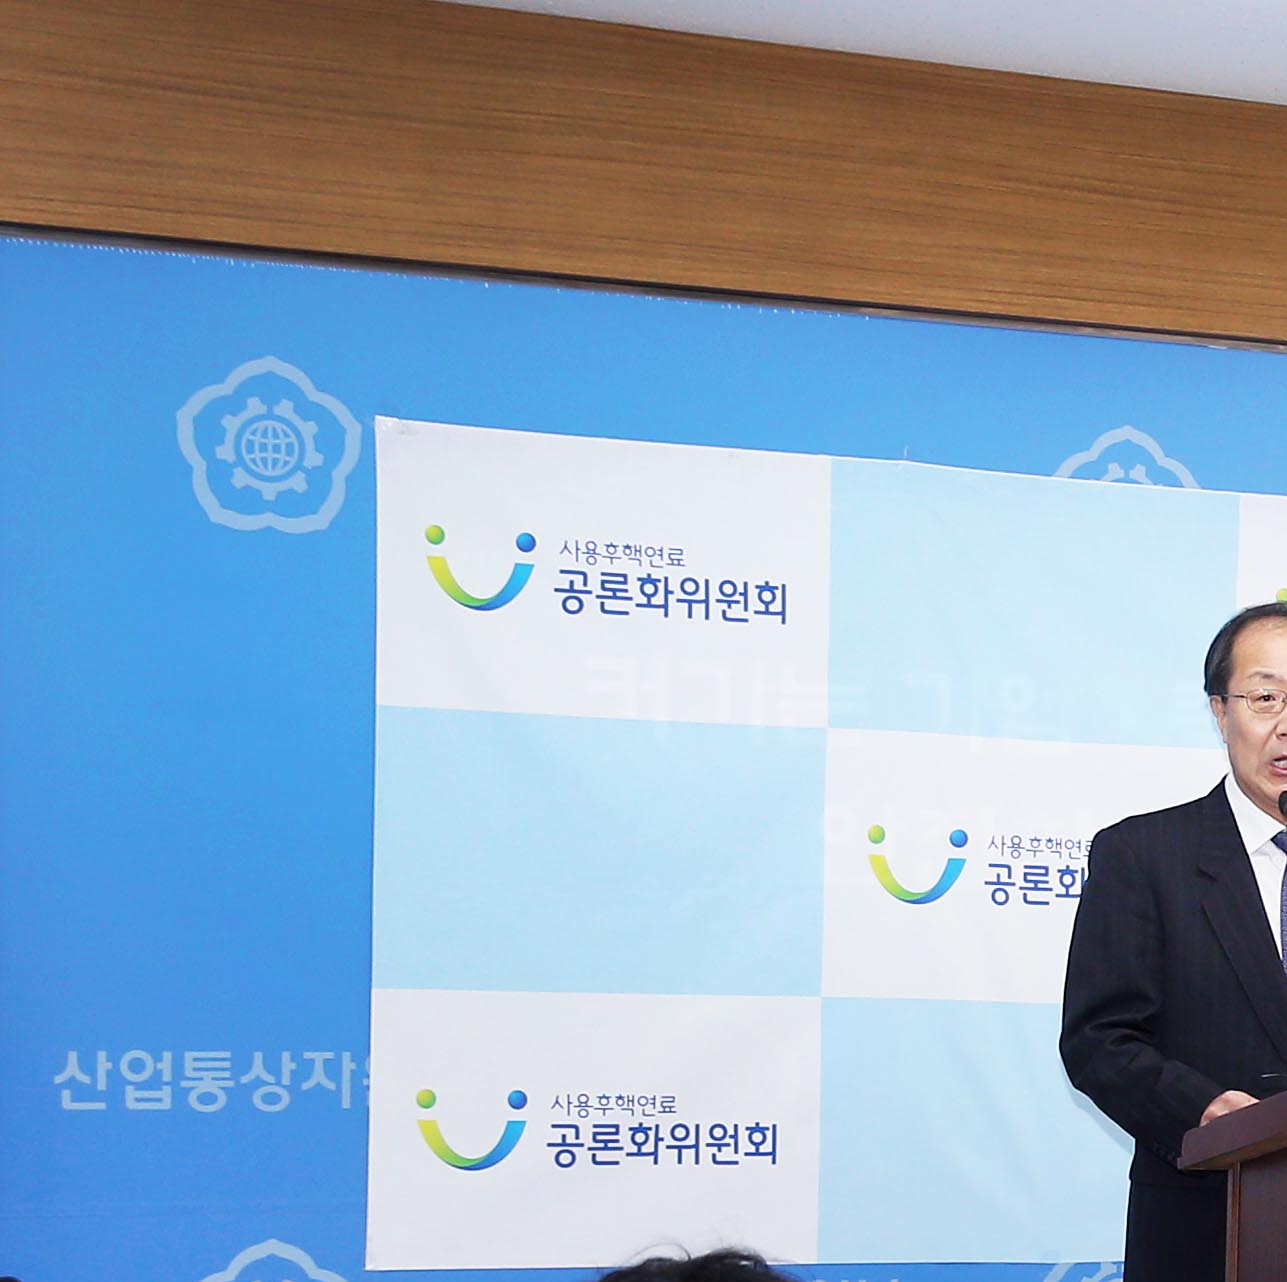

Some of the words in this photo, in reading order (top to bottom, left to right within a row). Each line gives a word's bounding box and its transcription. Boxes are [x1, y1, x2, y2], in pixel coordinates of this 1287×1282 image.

[559, 540, 686, 569] 사용후핵연료
[553, 569, 787, 625] 공론화위원회
[984, 863, 1087, 906] 공론화
[53, 1049, 369, 1113] 산업통상자
[550, 1093, 677, 1119] 사용후핵연료
[546, 1121, 777, 1169] 공론화위원회
